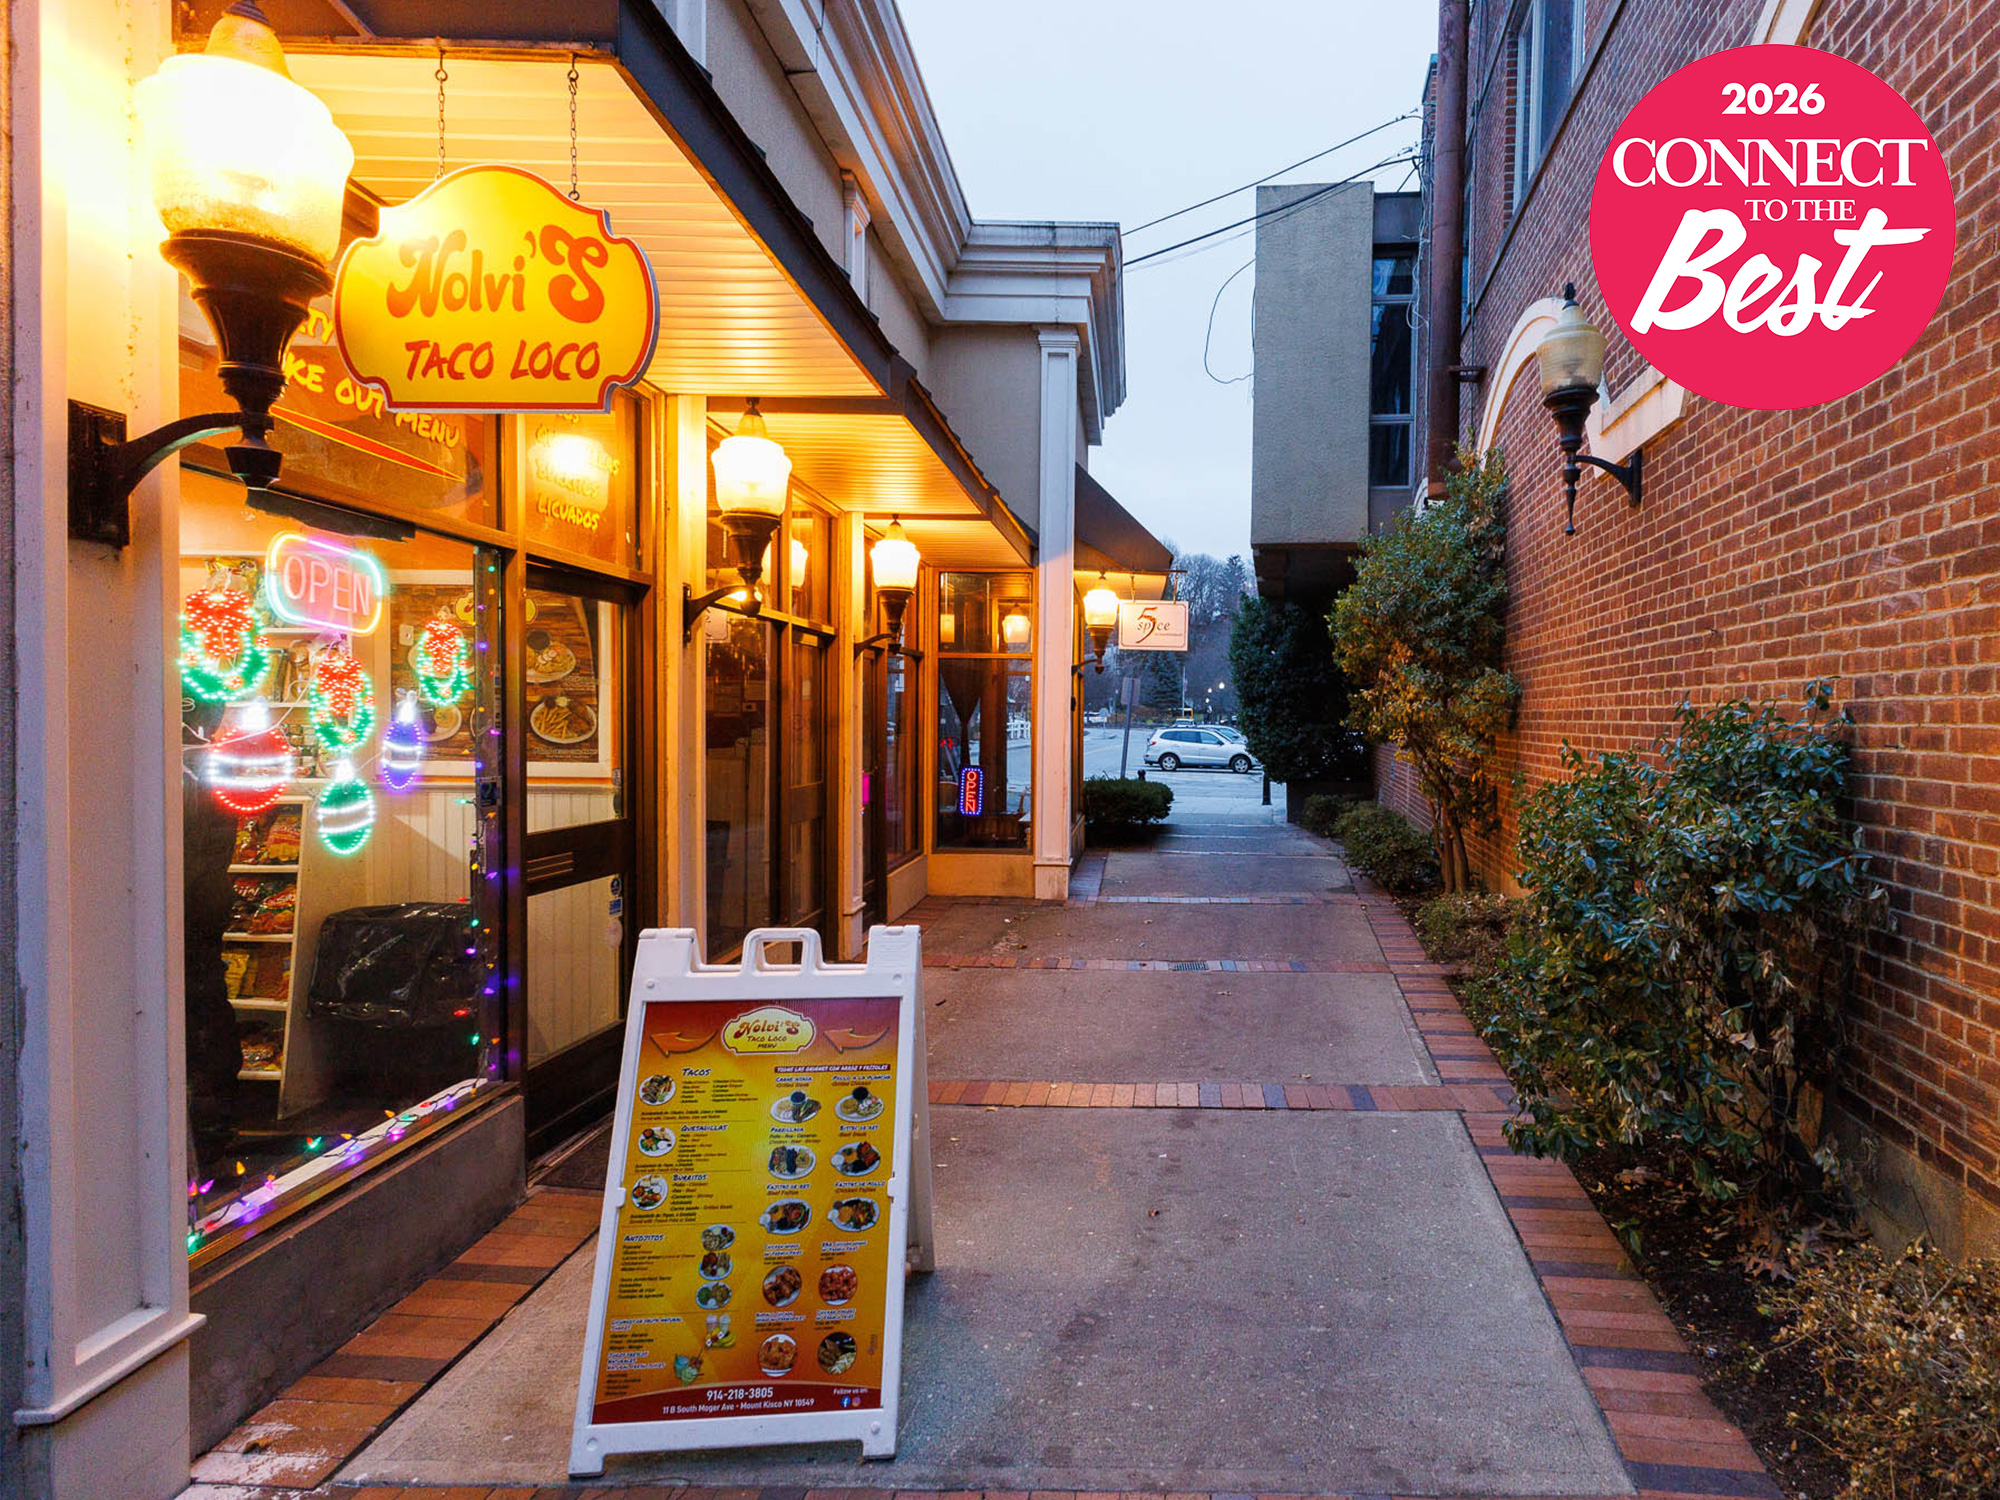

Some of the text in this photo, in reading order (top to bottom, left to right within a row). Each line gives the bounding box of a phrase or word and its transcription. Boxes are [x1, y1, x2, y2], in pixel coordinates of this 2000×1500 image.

[405, 339, 600, 381] TACO LOCO
[284, 351, 460, 447] KE OUT MENU
[536, 496, 600, 531] LICUADOS
[283, 555, 370, 616] OPEN
[965, 770, 978, 812] OPEN
[682, 1067, 712, 1076] TACOS
[673, 1174, 708, 1182] BURRITOS
[677, 1405, 697, 1413] South
[698, 1403, 720, 1413] Moger
[721, 1402, 734, 1411] Ave
[740, 1401, 762, 1409] Mount
[763, 1400, 783, 1408] Kisco
[784, 1399, 794, 1407] NY
[795, 1397, 815, 1406] 10549
[706, 1387, 774, 1401] 914-218-3805
